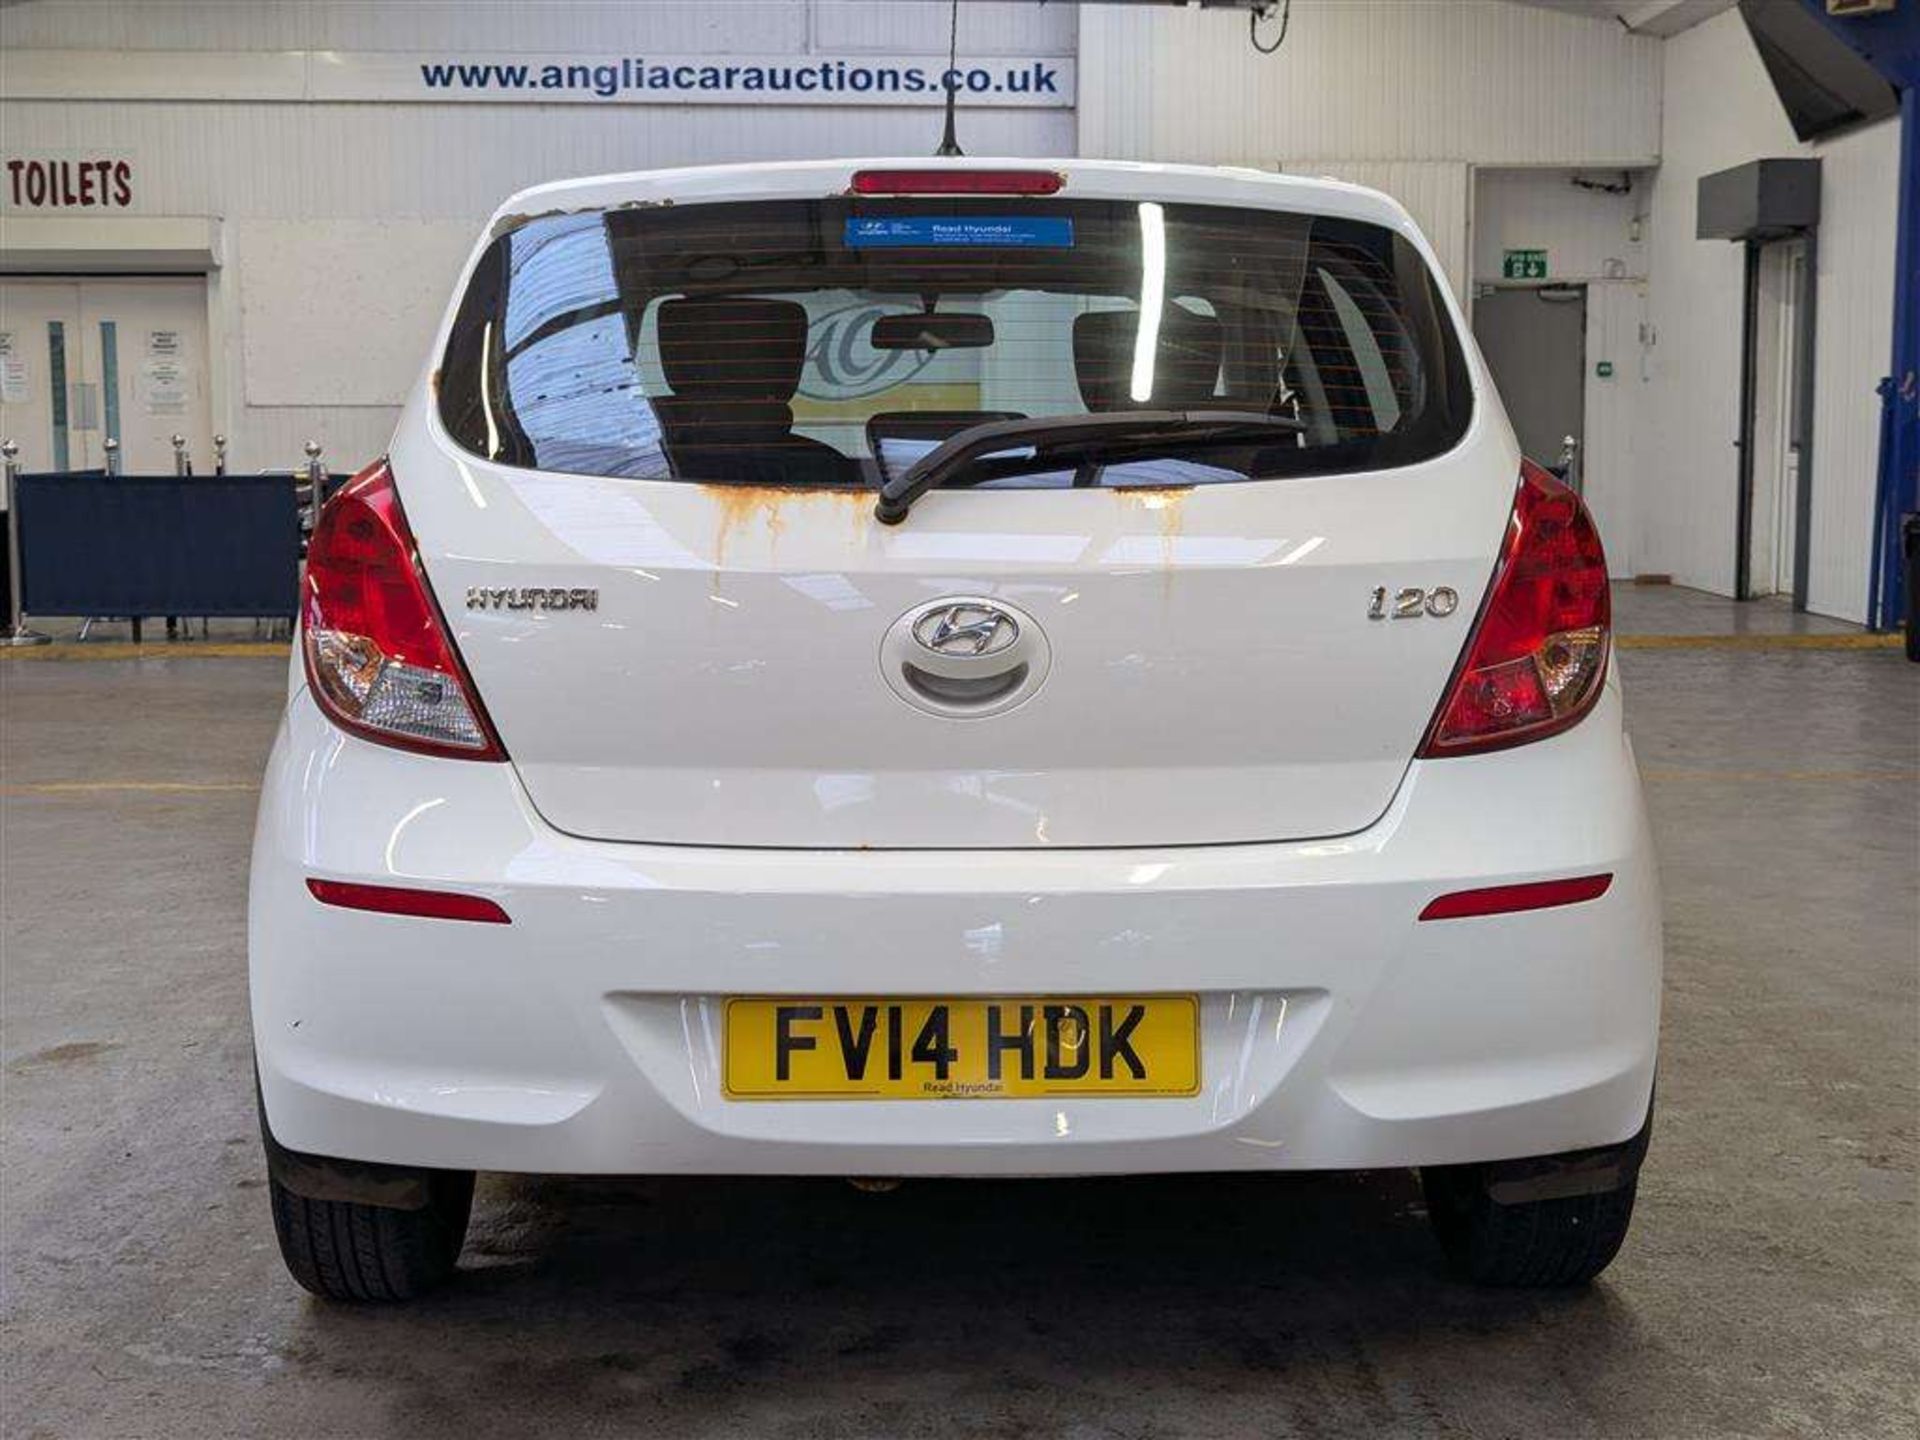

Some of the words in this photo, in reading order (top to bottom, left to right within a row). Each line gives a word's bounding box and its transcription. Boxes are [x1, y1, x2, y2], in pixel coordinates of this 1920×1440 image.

[421, 58, 1057, 96] www.angliacarauctions.co.uk
[7, 160, 131, 206] TOILETS
[466, 586, 598, 610] HYUNDAI
[776, 1005, 958, 1081] FV14
[987, 1005, 1146, 1081] HDK
[923, 1082, 953, 1092] Read
